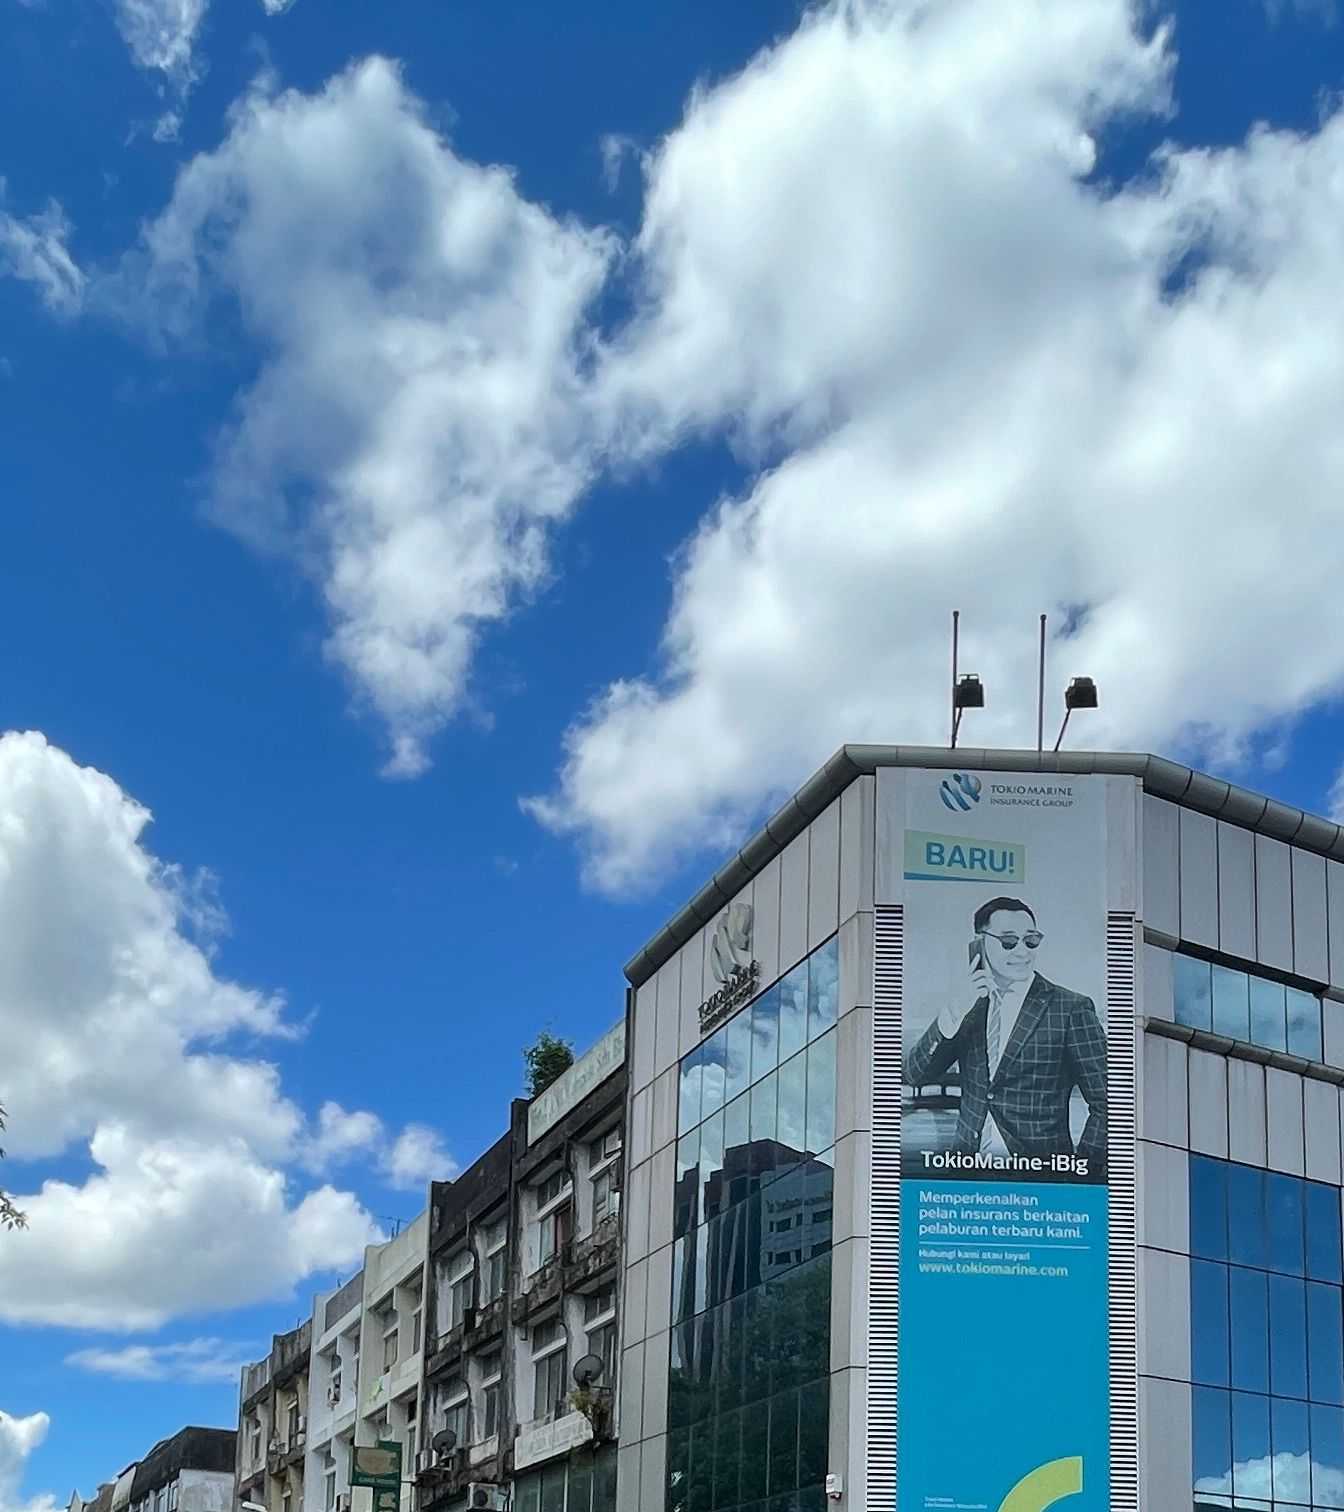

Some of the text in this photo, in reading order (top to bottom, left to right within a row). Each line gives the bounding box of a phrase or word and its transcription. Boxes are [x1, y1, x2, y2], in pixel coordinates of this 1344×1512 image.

[991, 784, 1074, 797] TOKIO MARINE
[990, 798, 1074, 808] INSURANCE GROUP
[925, 841, 1015, 874] BARU!
[920, 1150, 1089, 1176] TokioMarine-iBig
[919, 1190, 1039, 1206] Memperkenalkan
[918, 1207, 1090, 1223] pelan insurans berkaitan
[918, 1222, 1083, 1239] pelaburan terbaru kami.
[918, 1262, 1069, 1277] www.tokiomarine.com
